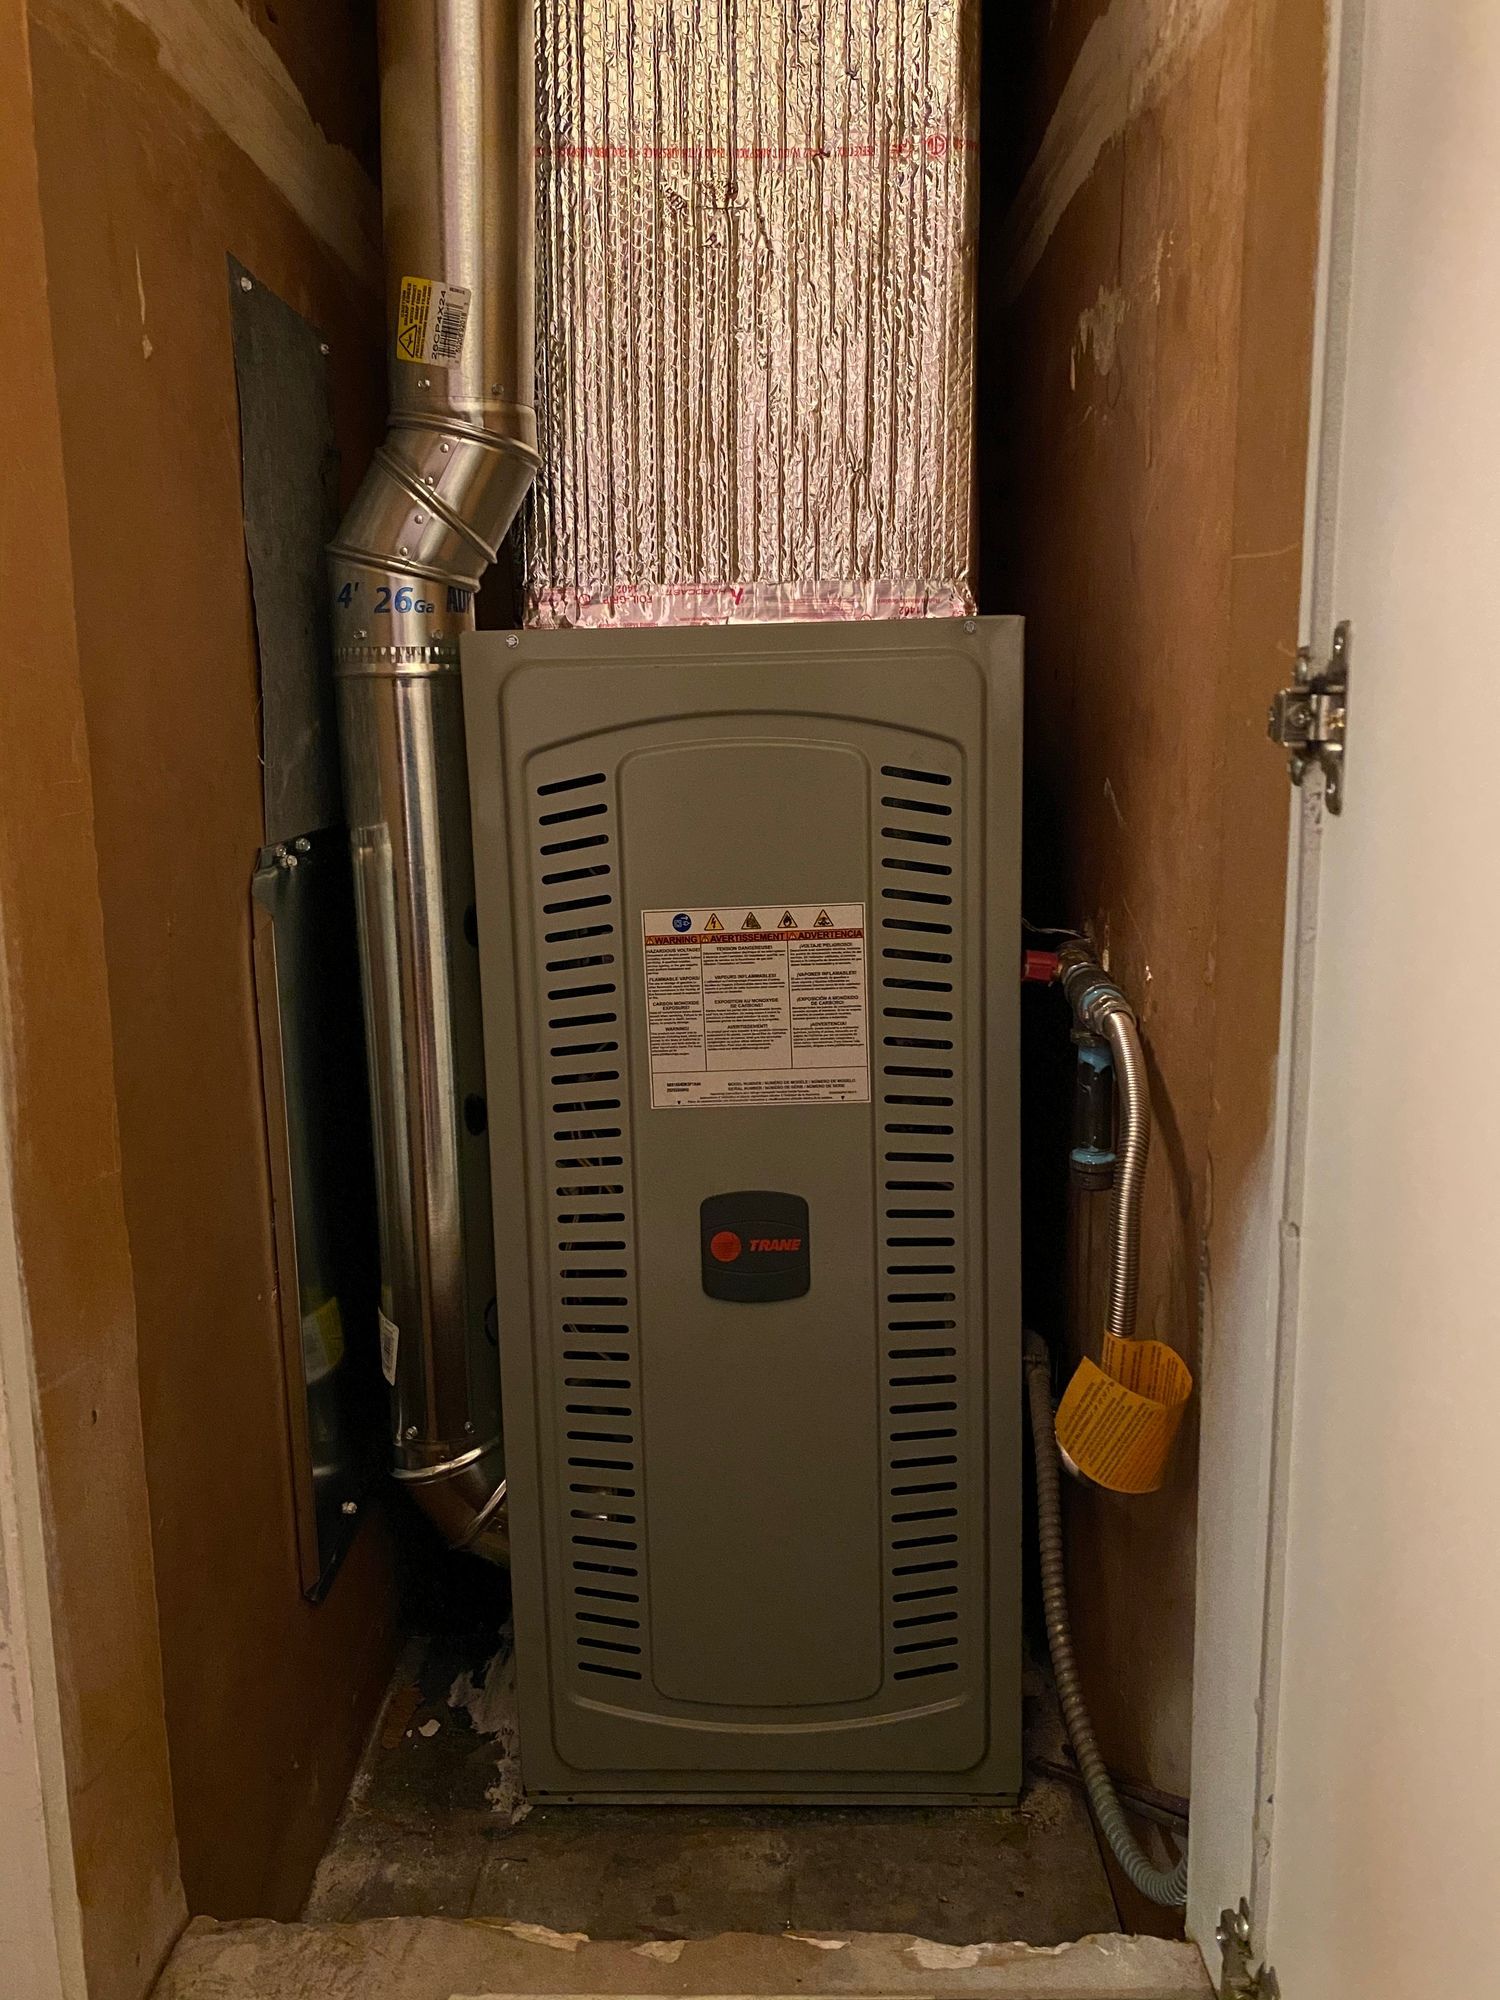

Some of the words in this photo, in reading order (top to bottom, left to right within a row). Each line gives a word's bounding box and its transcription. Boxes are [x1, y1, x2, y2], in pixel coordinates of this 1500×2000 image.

[432, 290, 446, 360] 26CP4X24
[616, 585, 638, 594] 1402
[602, 595, 653, 604] FOIL-GRIP
[899, 606, 920, 615] 1402
[711, 933, 783, 943] AVERTISSEMENT
[798, 930, 862, 939] ADVERTENCIA
[655, 936, 697, 944] WARNING
[749, 1238, 801, 1252] TRANE
